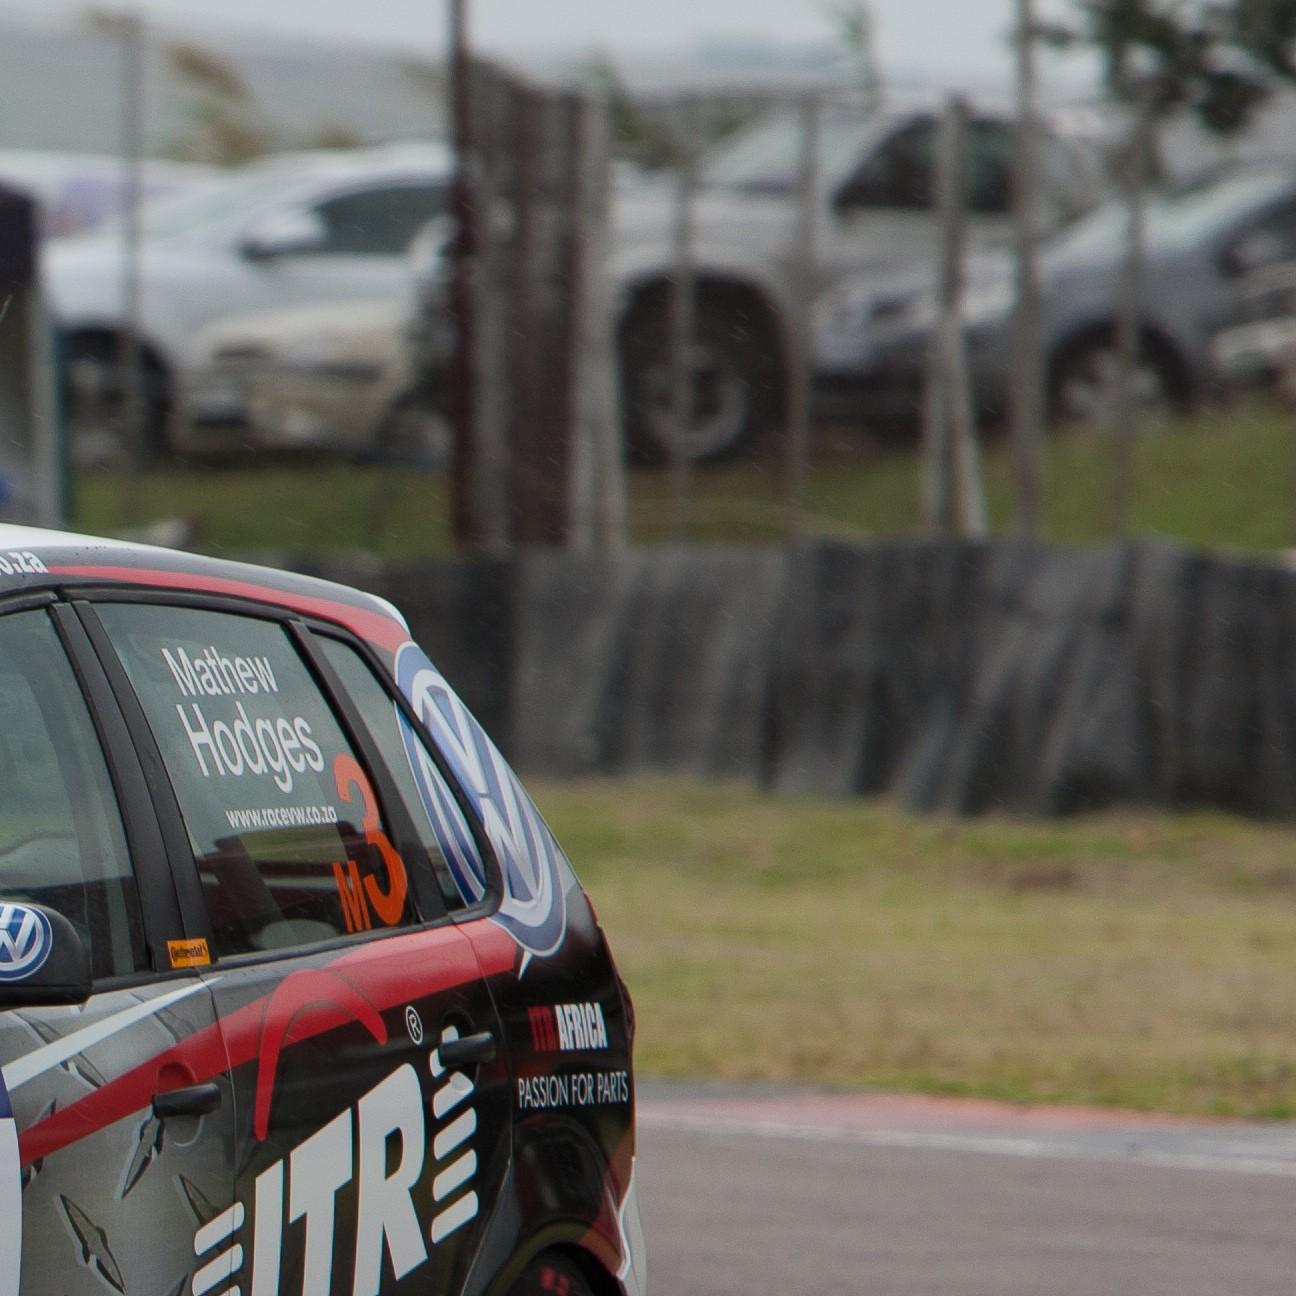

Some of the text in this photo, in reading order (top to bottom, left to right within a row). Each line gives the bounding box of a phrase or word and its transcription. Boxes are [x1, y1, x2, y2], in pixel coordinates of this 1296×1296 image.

[160, 645, 279, 698] Mathew
[175, 701, 325, 794] Hodges
[518, 1069, 629, 1110] PASSION FOR PARTS
